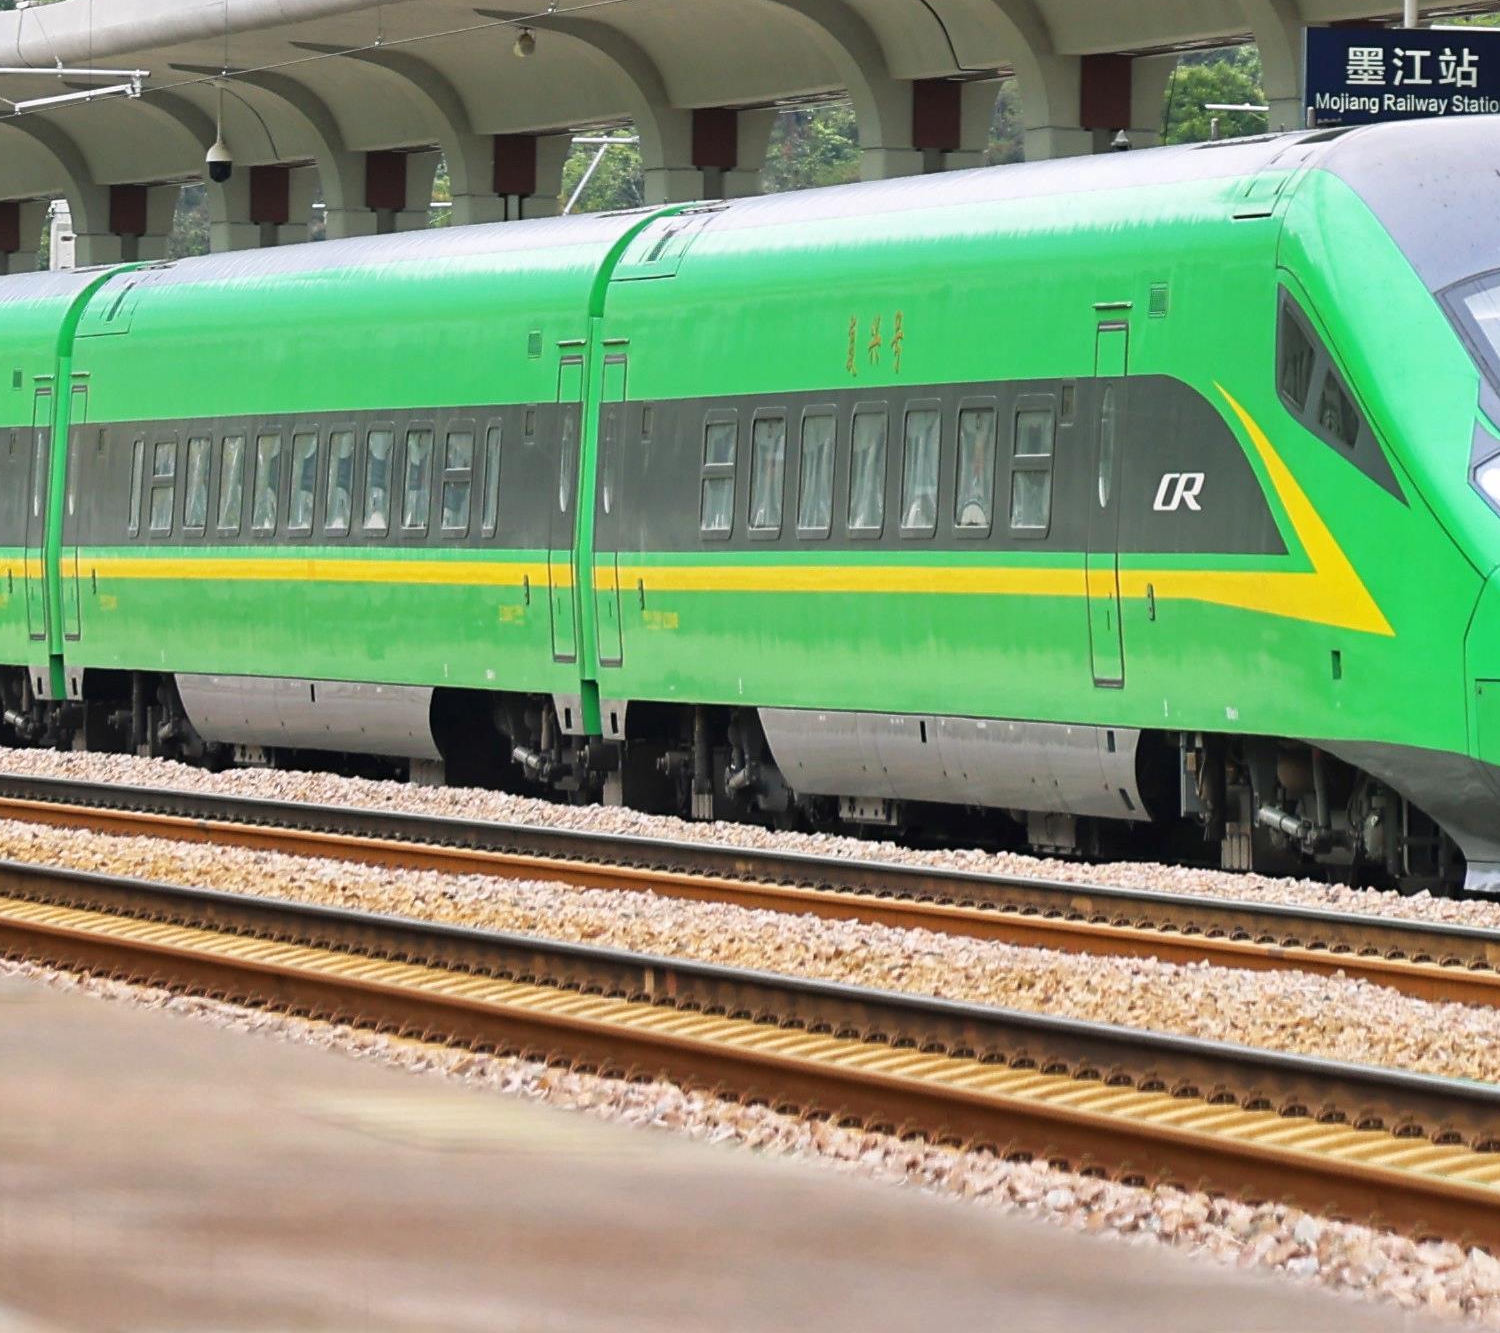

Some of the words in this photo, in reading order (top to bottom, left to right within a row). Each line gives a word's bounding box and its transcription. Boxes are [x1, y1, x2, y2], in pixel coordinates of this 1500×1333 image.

[1346, 47, 1479, 88] 墨江站
[1316, 93, 1379, 113] Mojiang
[1384, 94, 1448, 114] Railway
